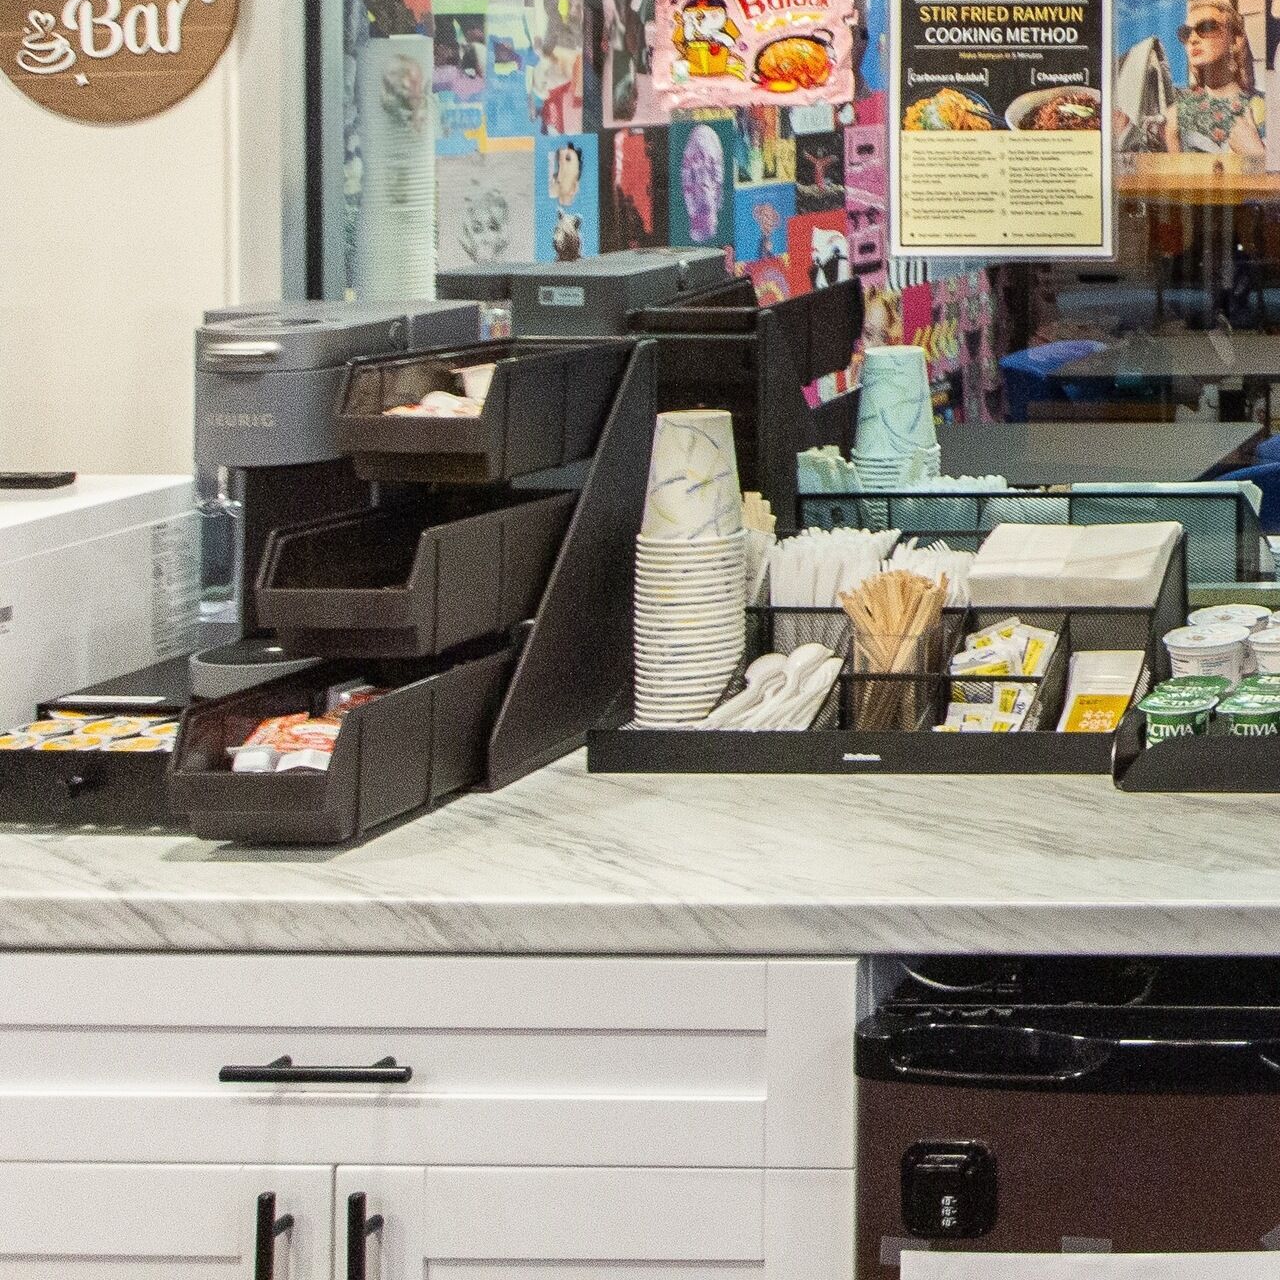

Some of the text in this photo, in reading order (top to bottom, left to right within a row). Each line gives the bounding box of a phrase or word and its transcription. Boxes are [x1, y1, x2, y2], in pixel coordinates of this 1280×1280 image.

[919, 6, 1084, 23] STIR FRIED RAMYUN
[925, 27, 1079, 44] COOKING METHOD
[1230, 723, 1278, 736] ACTIVIA
